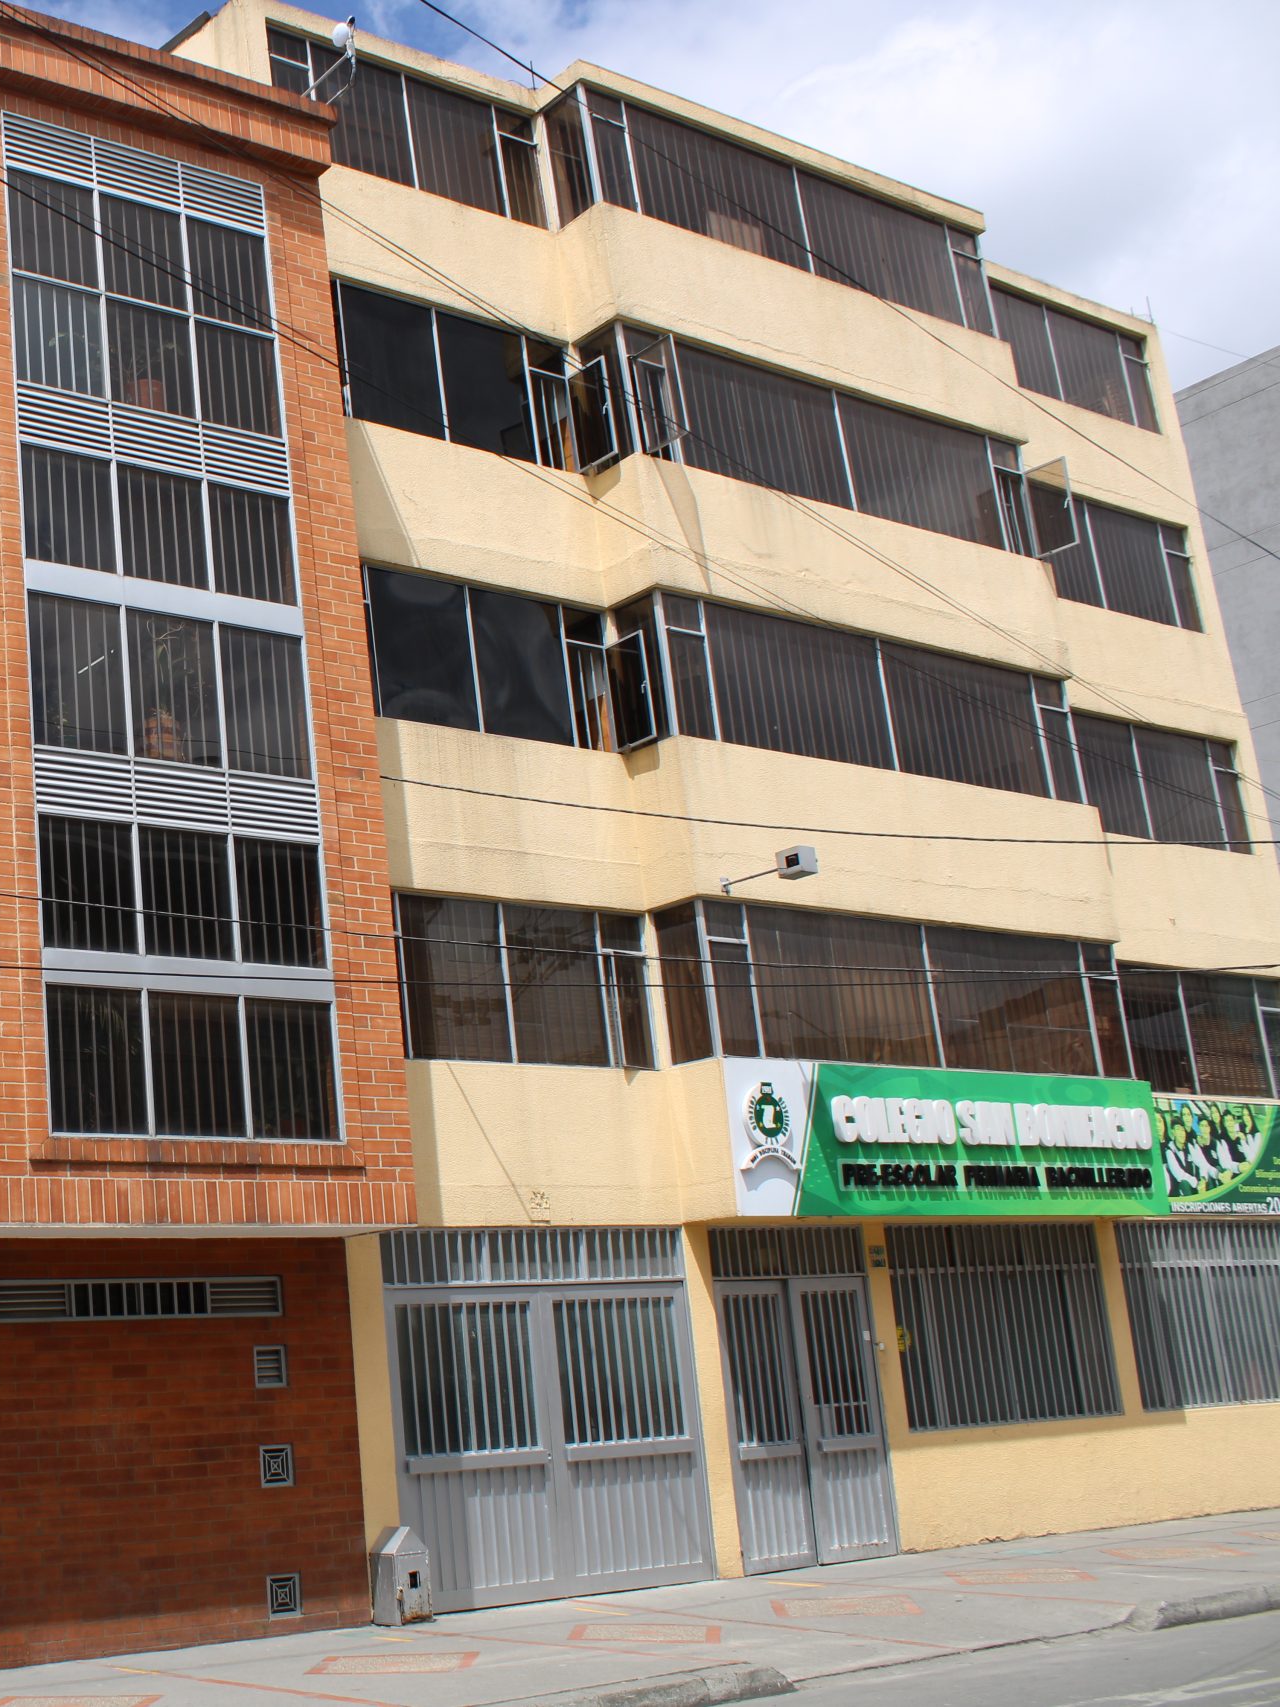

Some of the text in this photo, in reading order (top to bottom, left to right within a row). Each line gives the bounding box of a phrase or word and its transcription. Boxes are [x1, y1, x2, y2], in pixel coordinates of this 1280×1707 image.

[831, 1095, 1152, 1150] COLEGIO SAN BONIFACIO
[842, 1163, 1153, 1188] PRE-ESCOLAR PRIMARIA BACHILLERATO
[1171, 1201, 1231, 1213] INSCRIPCIONES
[1232, 1202, 1267, 1213] ABIERTAS
